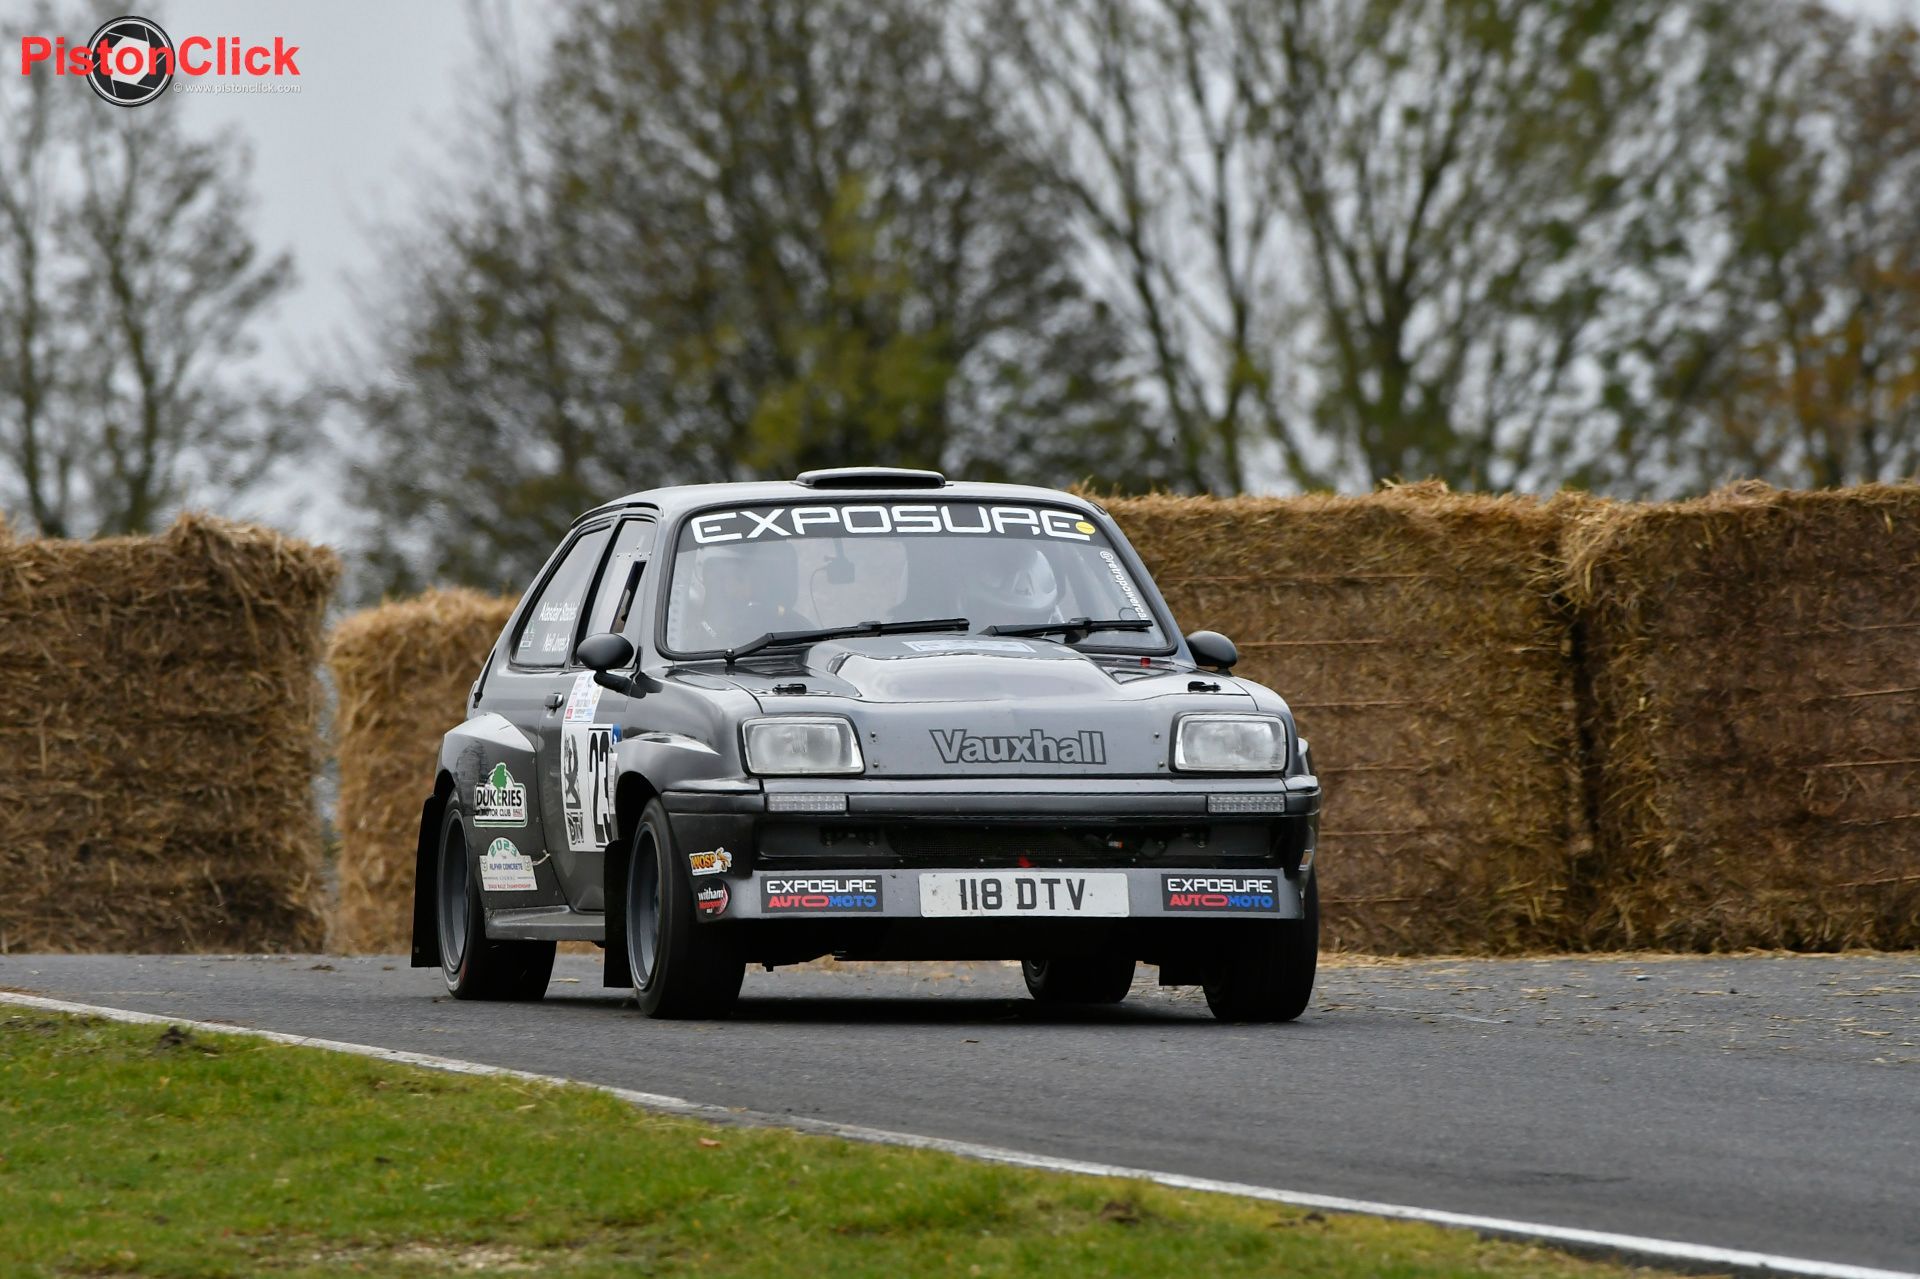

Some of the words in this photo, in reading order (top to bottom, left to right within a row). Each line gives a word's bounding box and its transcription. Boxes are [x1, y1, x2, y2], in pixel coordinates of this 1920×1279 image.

[691, 505, 1090, 544] EXPOSURE
[929, 728, 1106, 765] Vauxhall
[476, 789, 522, 807] DUKERIES
[499, 808, 511, 817] CLUB
[502, 863, 523, 871] CONCRETE
[691, 853, 716, 869] WOSP
[766, 879, 876, 893] EXPOSURE
[1167, 878, 1273, 893] EXPOSURE
[698, 887, 724, 901] witham
[958, 878, 1003, 911] 118
[1015, 878, 1085, 910] DTV
